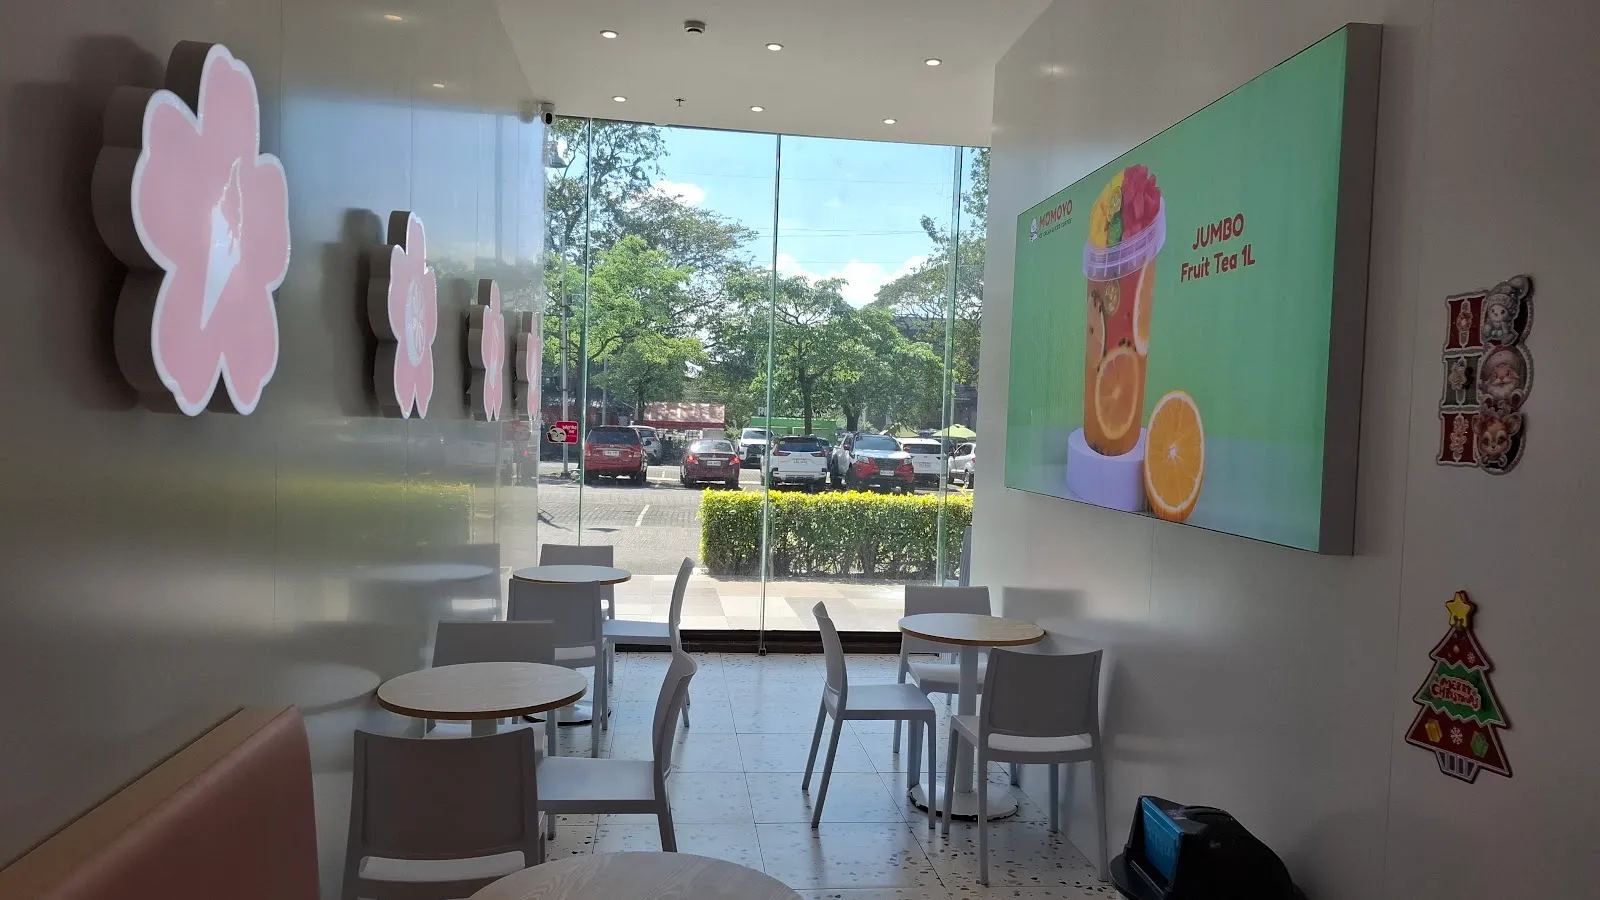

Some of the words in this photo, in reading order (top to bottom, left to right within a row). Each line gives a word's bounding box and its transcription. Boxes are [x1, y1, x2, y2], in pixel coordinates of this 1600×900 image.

[1039, 199, 1073, 229] MOMOYO
[1192, 212, 1245, 251] JUMBO
[1180, 256, 1211, 283] Fruit
[1213, 251, 1238, 274] Tea
[1241, 243, 1256, 267] 1L
[1431, 683, 1480, 710] CHRISTMAS
[1440, 677, 1473, 696] MERRY
